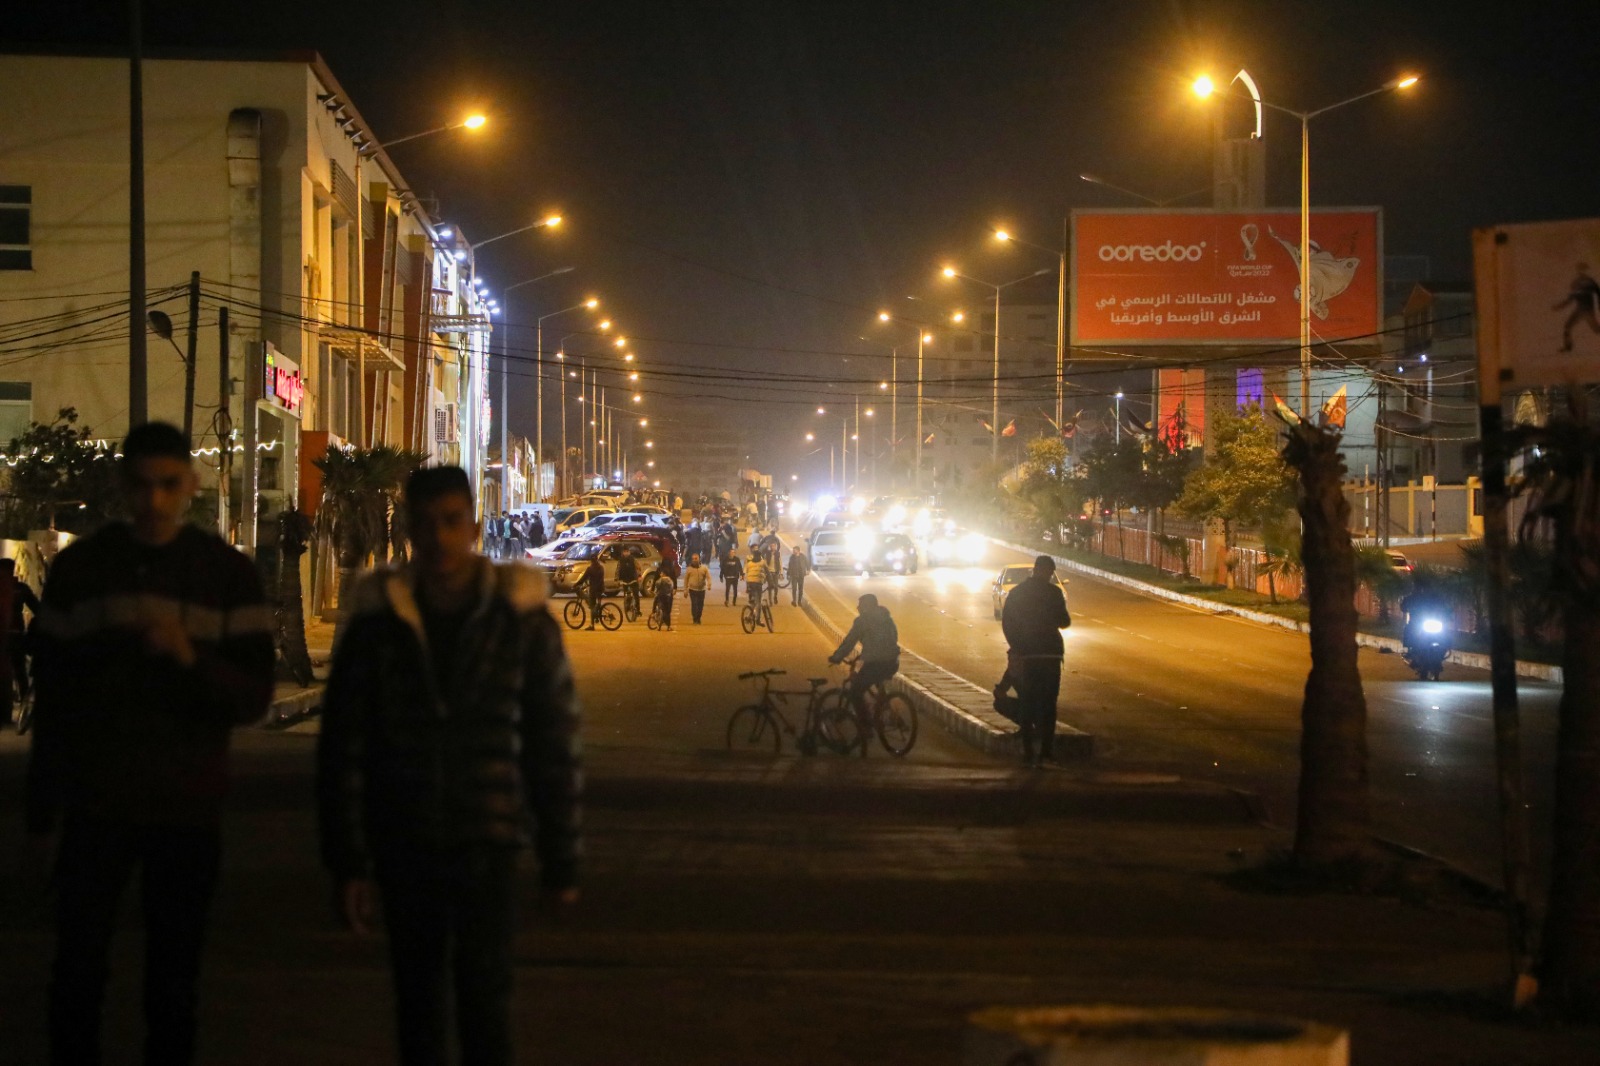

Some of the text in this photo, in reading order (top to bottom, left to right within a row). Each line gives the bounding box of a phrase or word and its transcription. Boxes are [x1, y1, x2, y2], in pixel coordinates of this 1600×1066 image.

[1098, 240, 1204, 262] ooredoo
[1095, 291, 1277, 310] مشغل الاتصالات الرسمي في
[1110, 309, 1261, 325] الشرق الأوسط وأفريقيا
